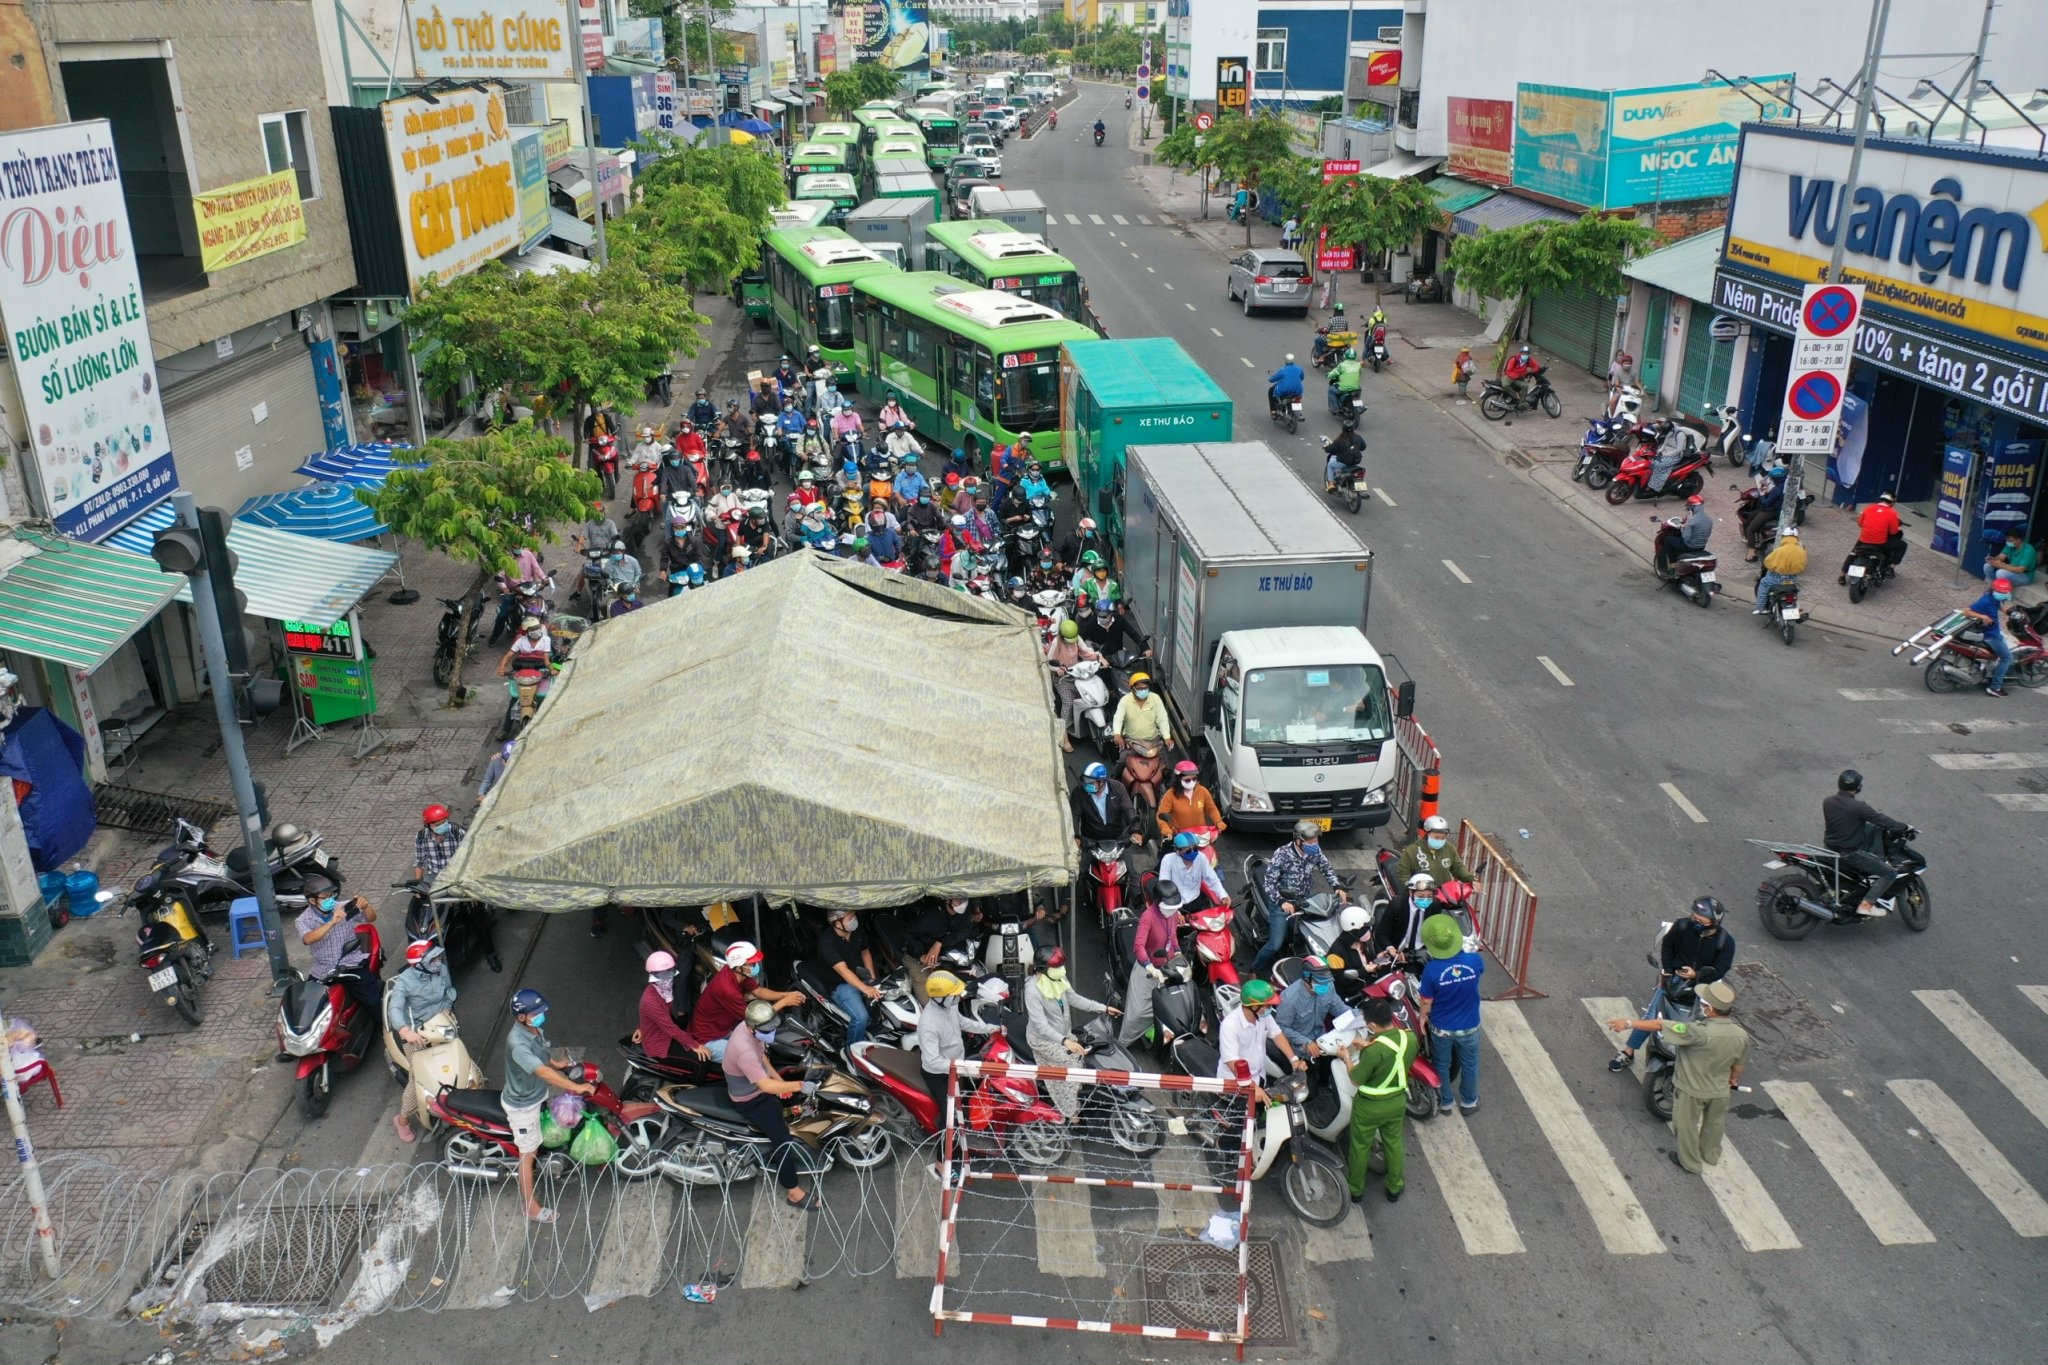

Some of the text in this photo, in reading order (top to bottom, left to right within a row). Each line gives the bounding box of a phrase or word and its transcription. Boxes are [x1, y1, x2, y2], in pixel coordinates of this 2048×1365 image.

[416, 4, 447, 50] ĐỒ
[452, 10, 495, 51] THỜ
[502, 10, 562, 52] CÚNG
[657, 84, 671, 93] SIM
[1218, 88, 1246, 106] LED
[658, 96, 673, 111] 3G
[659, 115, 673, 128] 4G
[3, 148, 38, 199] THỜI
[35, 152, 78, 194] TRANG
[76, 133, 100, 186] TRẺ
[99, 147, 117, 182] EM
[1640, 143, 1739, 173] NGỌC ÁN
[409, 173, 455, 259] CÁT
[451, 155, 516, 240] TƯỜNG
[1, 206, 124, 291] Diệu
[1723, 281, 1801, 327] Nệm Pride
[15, 283, 141, 362] BUÔN BÁN SỈ & LẺ
[42, 337, 139, 404] SỐ LƯỢNG LỚN
[1005, 356, 1017, 367] 36
[1856, 324, 2035, 407] 10% + tặng 2 gối
[1140, 415, 1195, 427] XE THƯ BÁO
[1944, 471, 1959, 485] MUA
[1993, 477, 2024, 491] TẶNG
[1995, 464, 2036, 488] MUA 1
[1259, 572, 1313, 591] XE THƯ BÁO
[323, 636, 351, 653] 411
[1302, 757, 1340, 766] ISUZU
